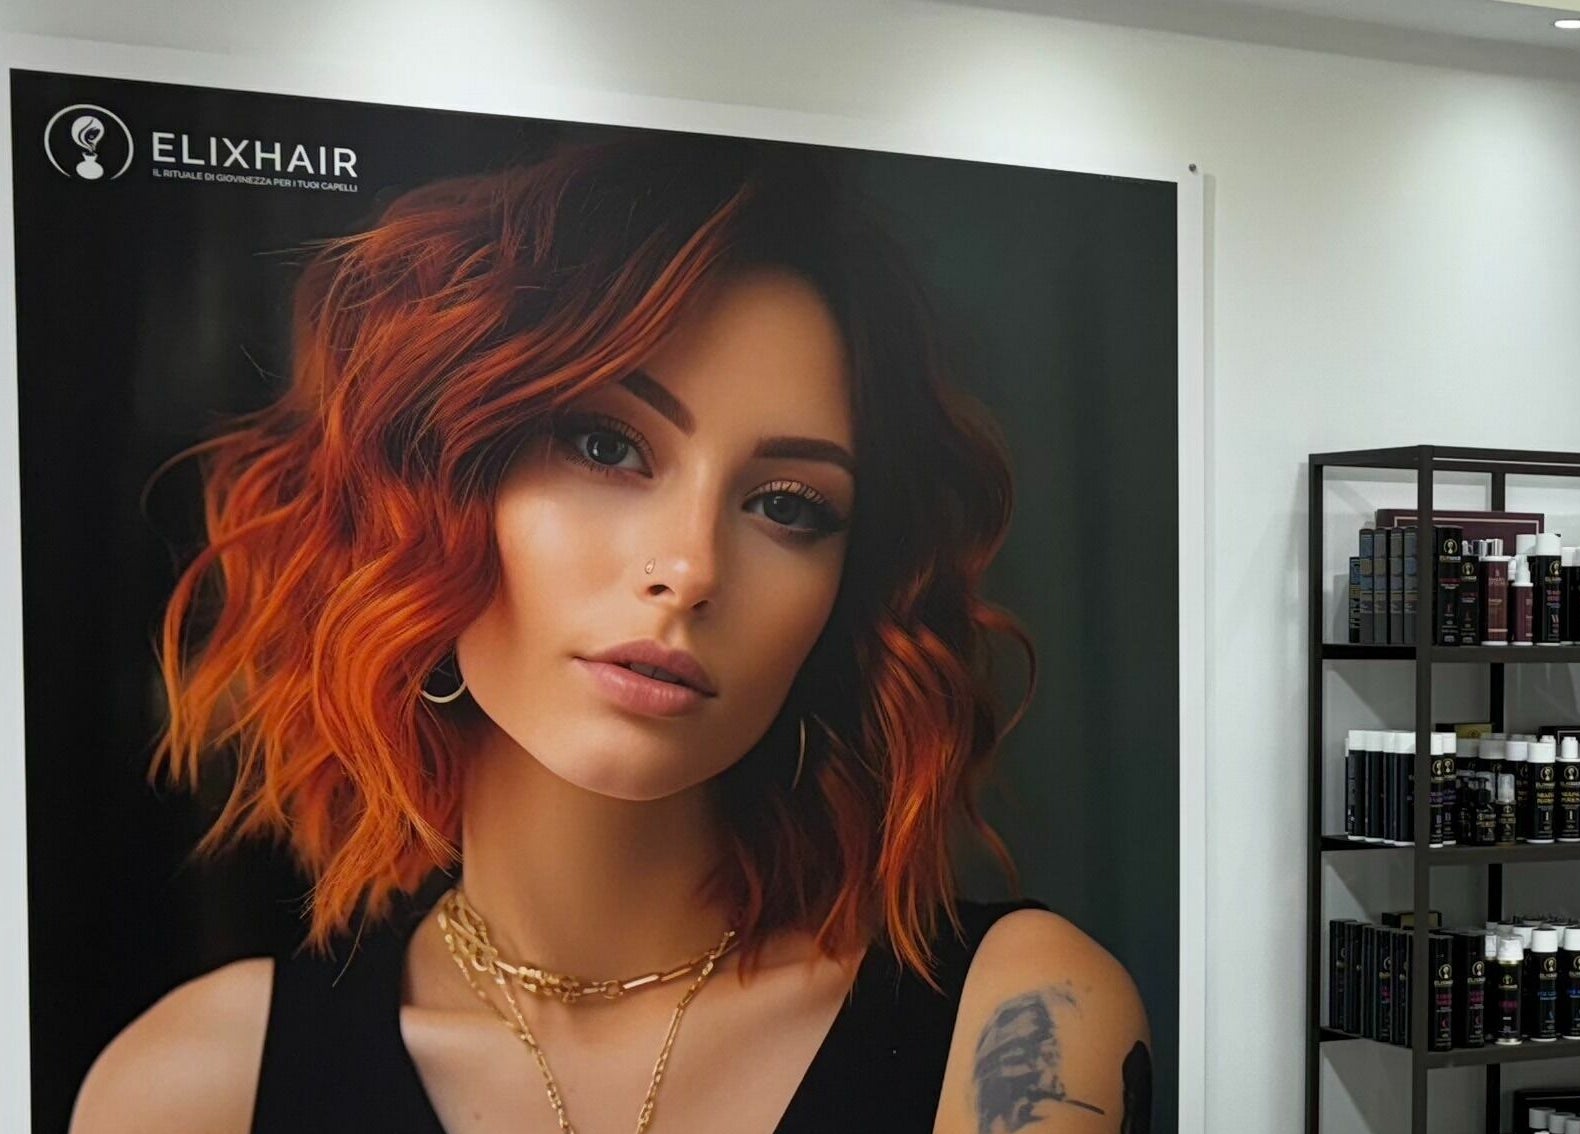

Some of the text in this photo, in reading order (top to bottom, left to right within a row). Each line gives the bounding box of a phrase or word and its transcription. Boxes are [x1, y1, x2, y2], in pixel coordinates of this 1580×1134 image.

[152, 131, 359, 178] ELIXHAIR
[152, 168, 162, 177] IL
[163, 169, 203, 181] RITUALE
[204, 173, 215, 182] DI
[273, 178, 292, 187] PER
[321, 182, 358, 193] CAPELLI
